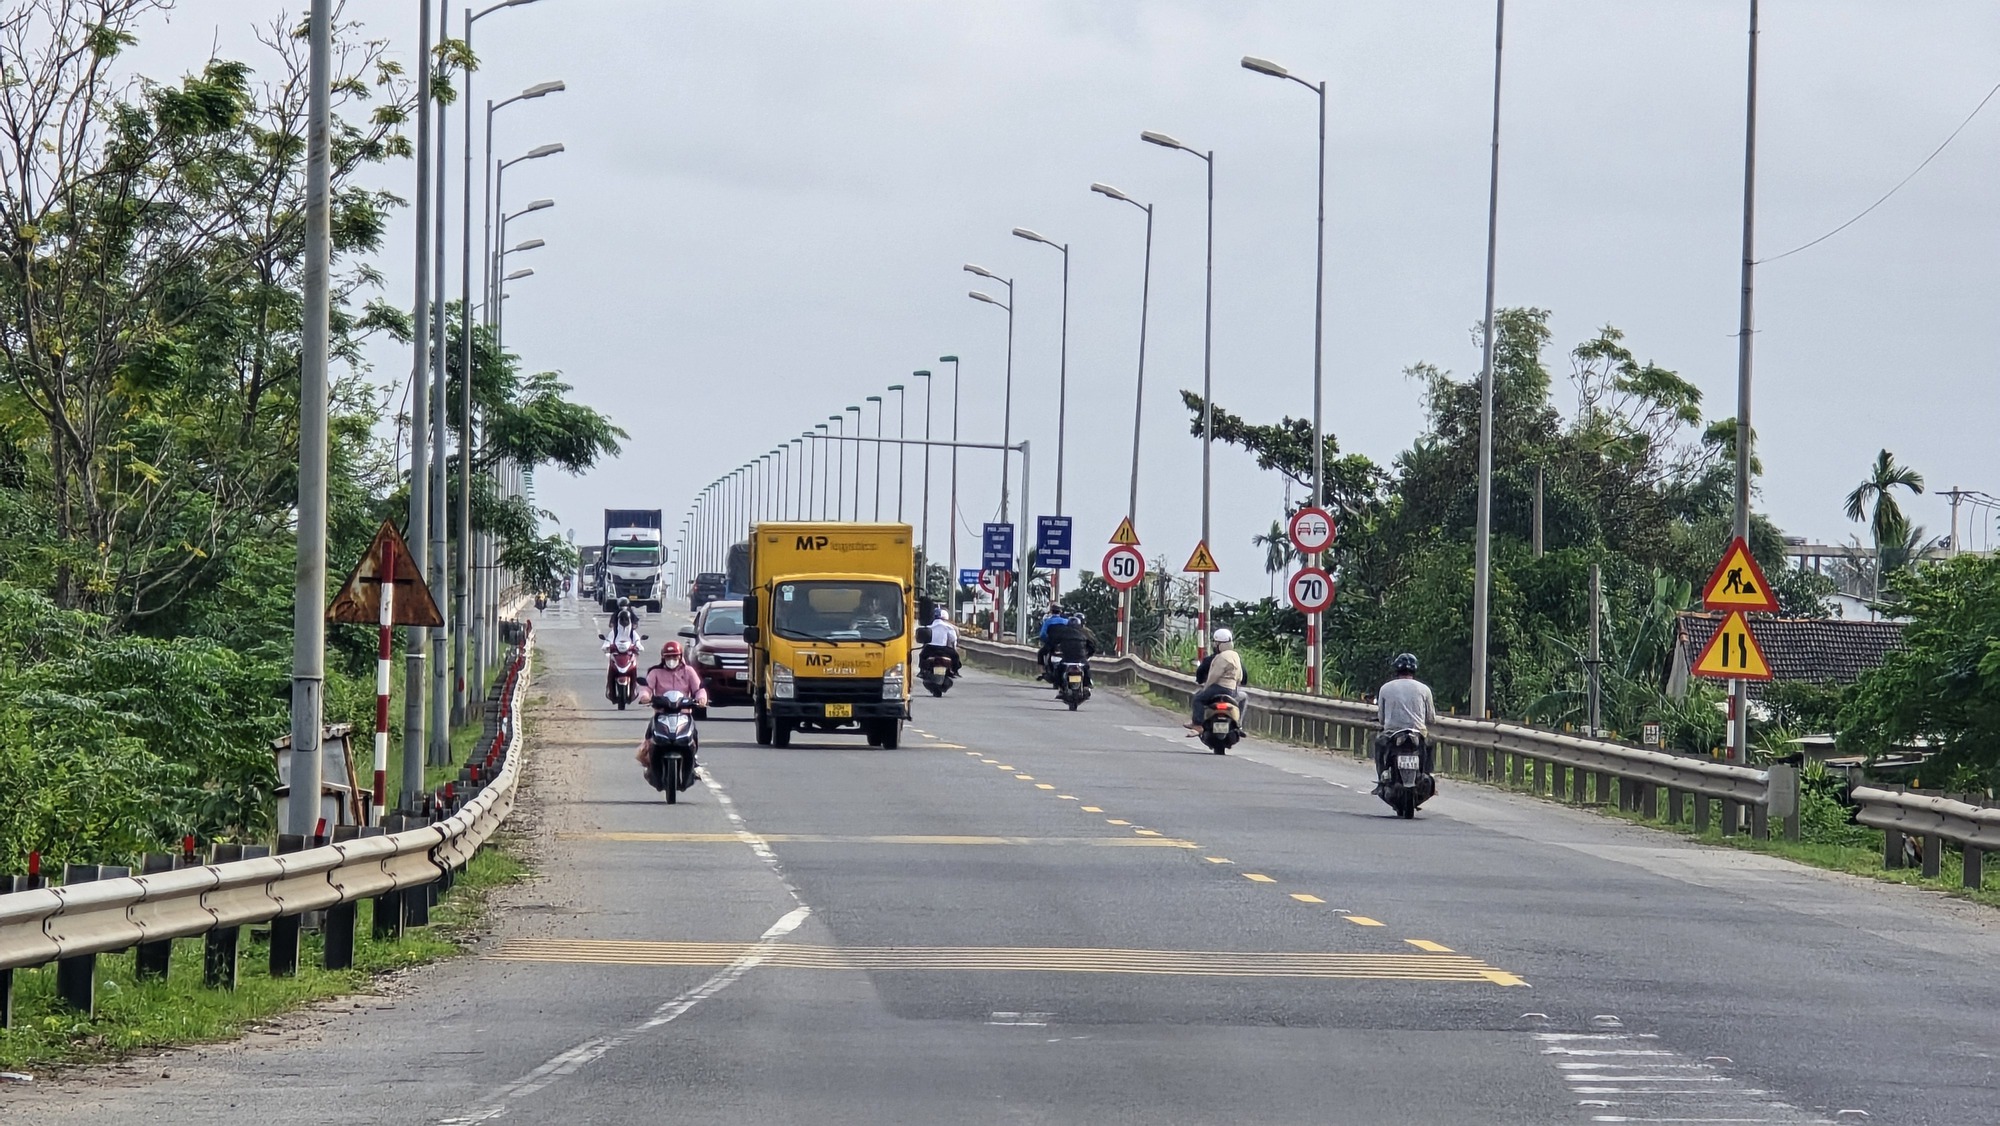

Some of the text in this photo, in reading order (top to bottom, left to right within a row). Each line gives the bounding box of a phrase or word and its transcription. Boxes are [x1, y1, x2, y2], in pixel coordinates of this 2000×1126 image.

[796, 535, 829, 551] MP
[1112, 557, 1135, 577] 50
[1298, 579, 1323, 601] 70
[805, 654, 833, 667] MP
